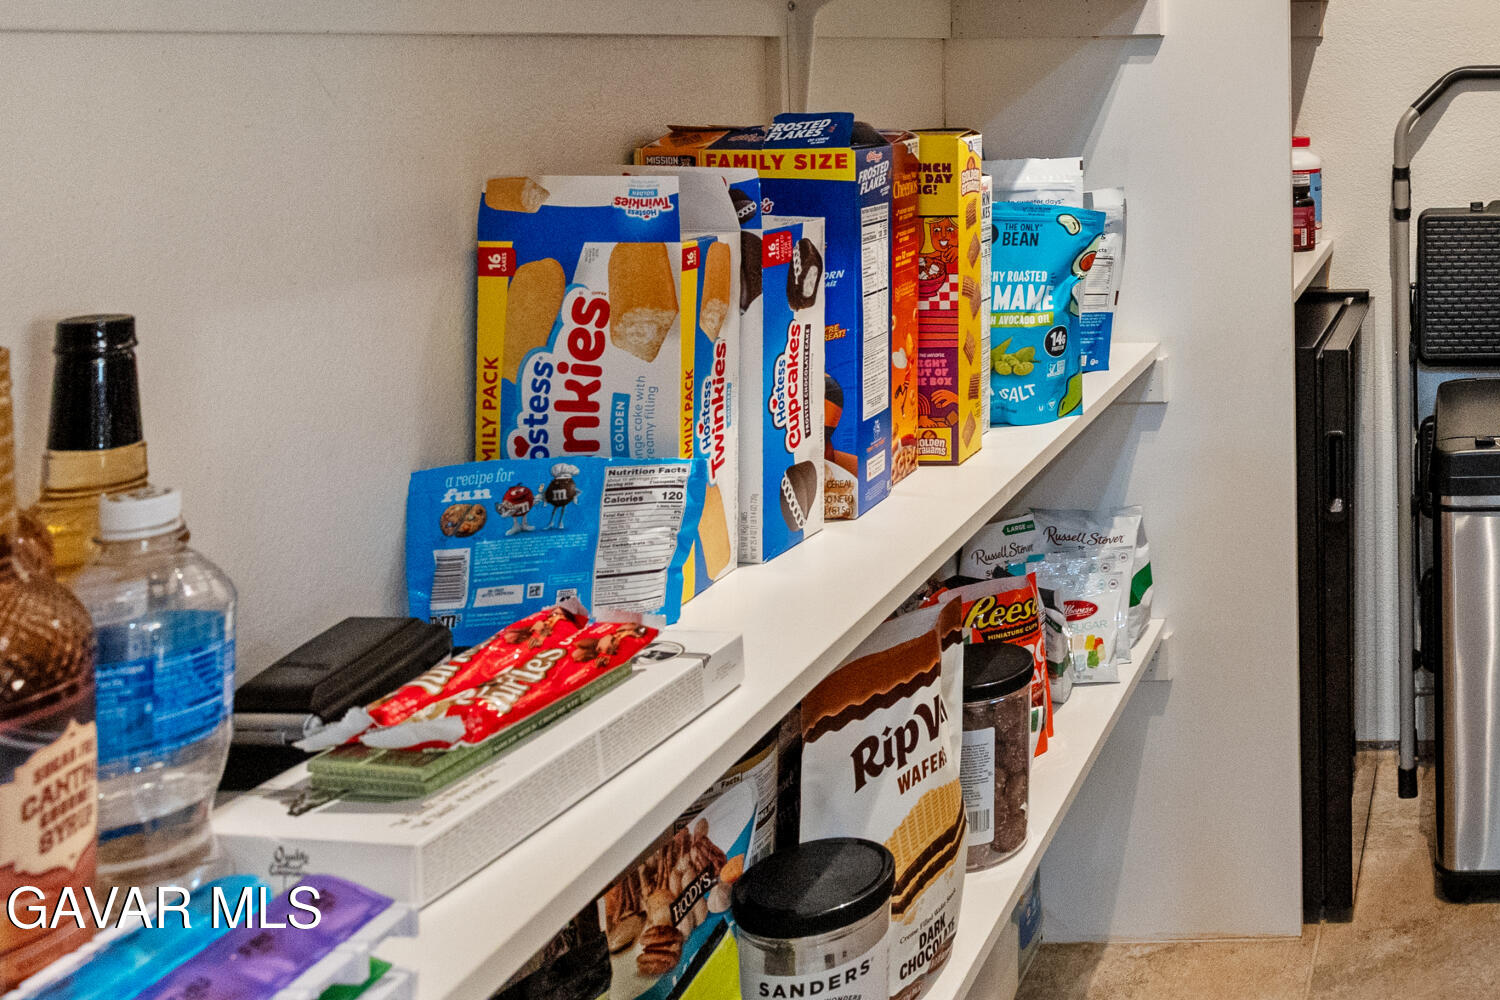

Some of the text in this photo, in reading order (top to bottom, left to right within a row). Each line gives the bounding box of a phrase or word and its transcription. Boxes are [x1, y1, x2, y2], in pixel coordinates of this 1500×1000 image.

[766, 127, 822, 141] FLAKES
[770, 119, 831, 134] FROSTED
[646, 156, 678, 165] MISSION
[706, 153, 849, 171] FAMILY SIZE
[858, 160, 889, 184] FROSTED
[925, 173, 953, 184] DAY
[860, 175, 888, 195] FLAKES
[614, 196, 673, 210] Twinkies
[627, 208, 657, 219] Hostess
[1005, 223, 1039, 231] THE ONLY
[1003, 232, 1039, 246] BEAN
[768, 244, 777, 258] 16
[488, 253, 501, 271] 16
[1008, 271, 1048, 283] ROASTED
[998, 313, 1052, 325] AVOCADO OIL
[484, 357, 499, 402] PACK
[787, 323, 802, 450] Cupcakes
[681, 368, 694, 411] PACK
[777, 359, 787, 424] Hostess
[1001, 383, 1036, 403] SALT
[635, 375, 646, 427] cake with
[648, 386, 659, 421] filling
[710, 341, 727, 480] Twinkies
[702, 380, 712, 451] Hostess
[616, 400, 625, 452] GOLDEN
[454, 472, 491, 488] recipe
[493, 468, 515, 484] for
[608, 466, 687, 477] Nutrition Facts
[826, 480, 851, 488] CEREAL
[440, 486, 492, 503] fun
[603, 491, 683, 504] Calories 120
[1006, 523, 1026, 533] LARGE
[1043, 526, 1125, 546] Russell Stover
[971, 545, 1009, 565] Russell
[988, 628, 1023, 641] MINIATURE
[1071, 621, 1108, 632] SUGAR
[850, 718, 920, 793] Rip
[672, 871, 713, 922] HOODY'S
[918, 912, 946, 950] DARK
[900, 917, 956, 981] CHOCOLATE
[759, 958, 871, 1000] SANDERS
